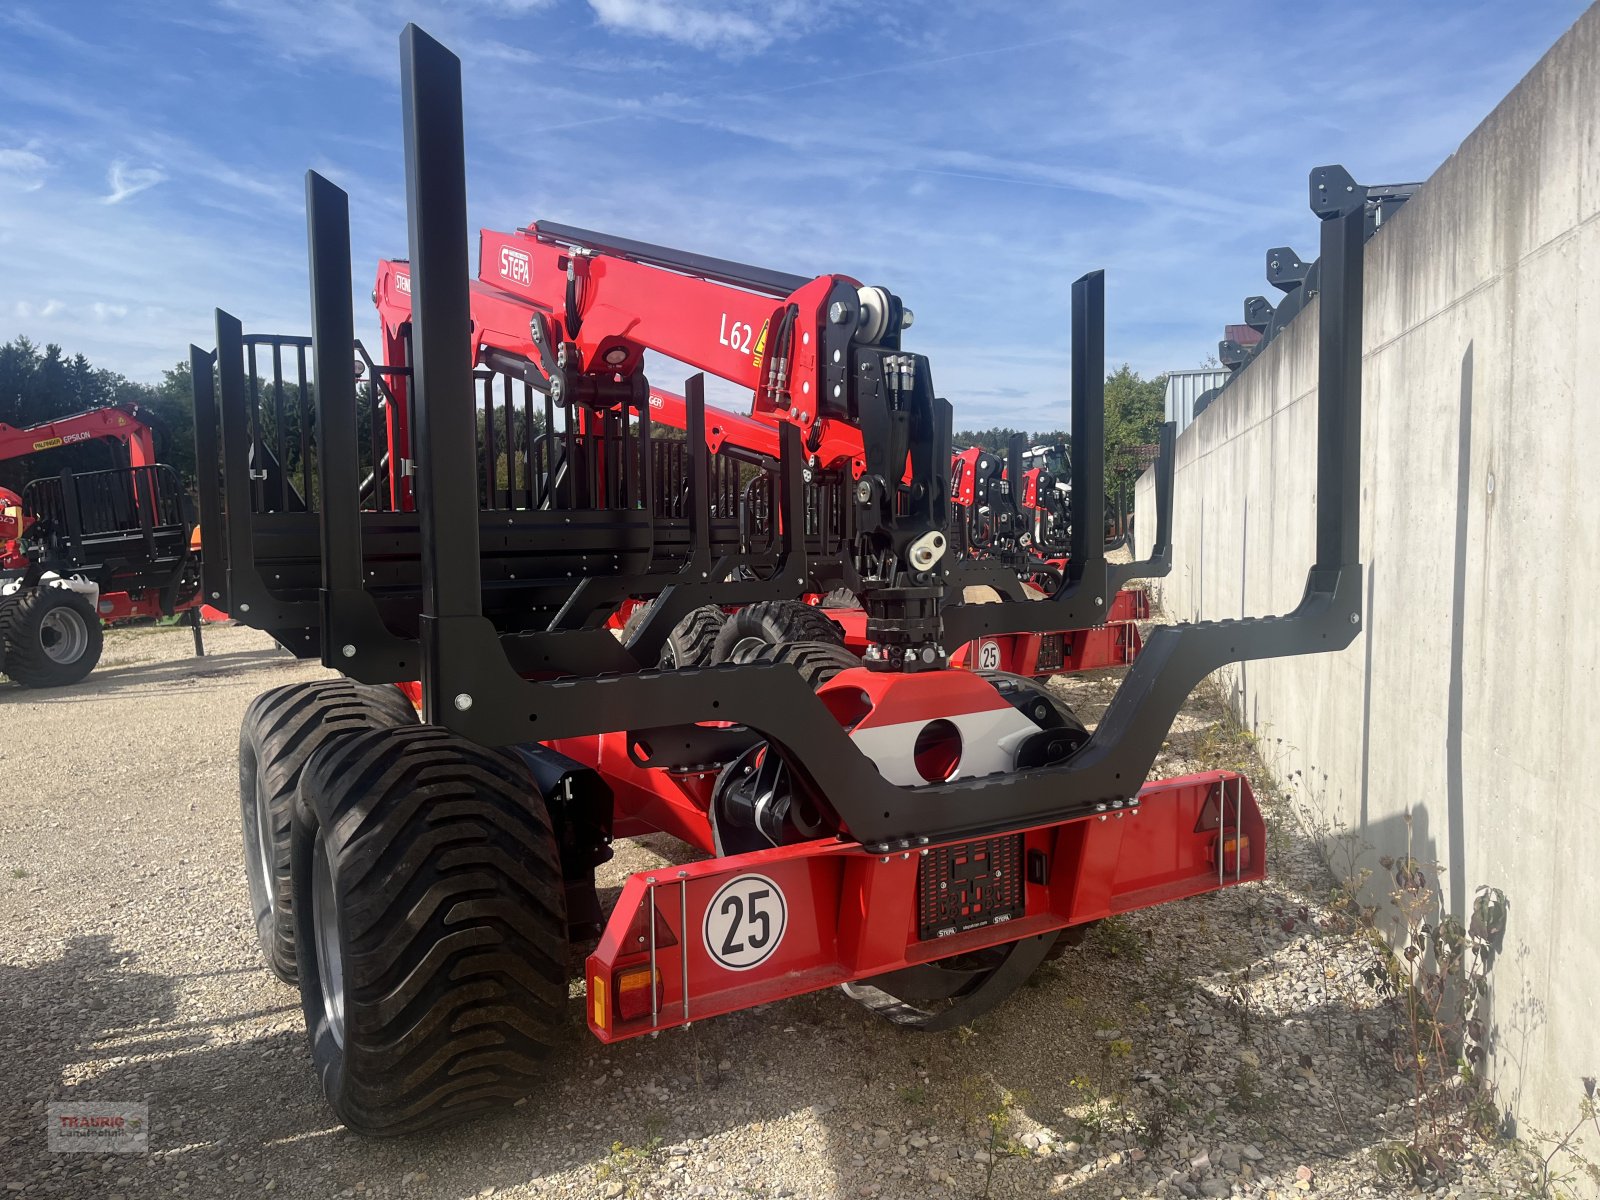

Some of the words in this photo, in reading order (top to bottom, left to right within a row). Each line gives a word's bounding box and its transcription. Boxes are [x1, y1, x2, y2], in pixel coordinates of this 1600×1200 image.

[501, 248, 530, 284] STEPA
[396, 274, 411, 292] STEN
[719, 312, 752, 355] L62
[649, 395, 662, 407] GER
[63, 431, 91, 443] EPSILON
[983, 647, 997, 668] 25
[721, 889, 770, 956] 25
